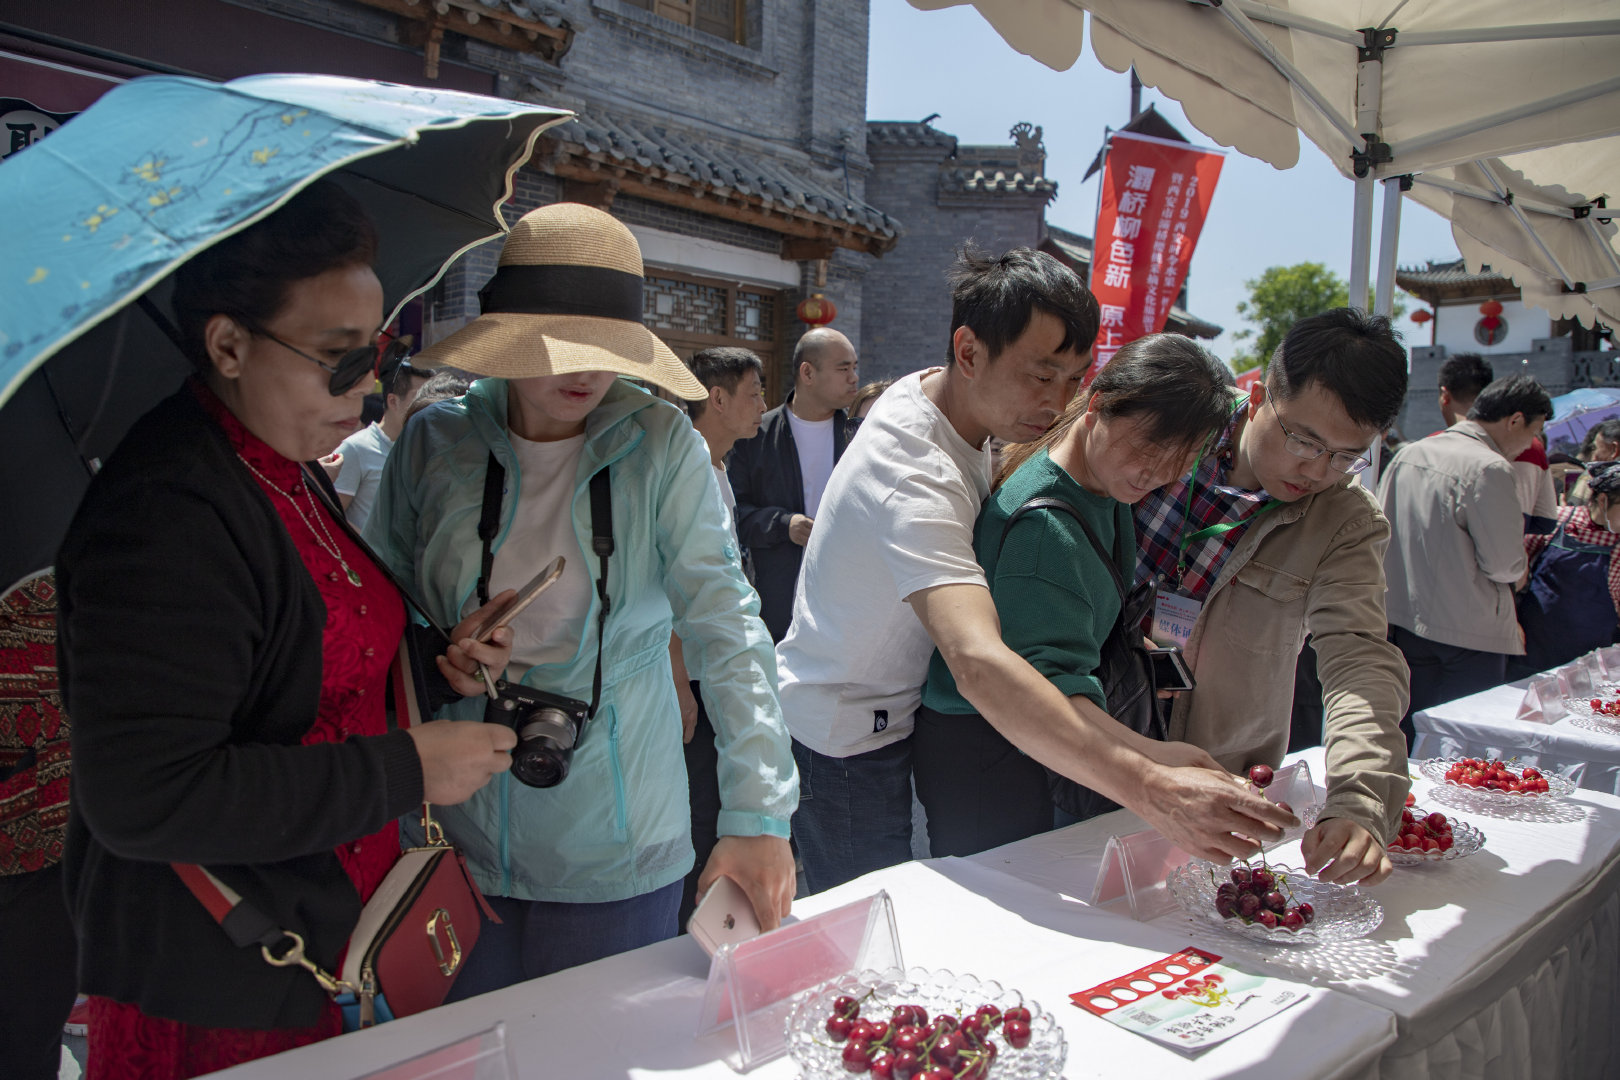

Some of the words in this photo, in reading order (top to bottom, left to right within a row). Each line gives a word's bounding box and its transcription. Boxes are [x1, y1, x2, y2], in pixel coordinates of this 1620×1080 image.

[1104, 165, 1156, 289] 灞桥柳色新
